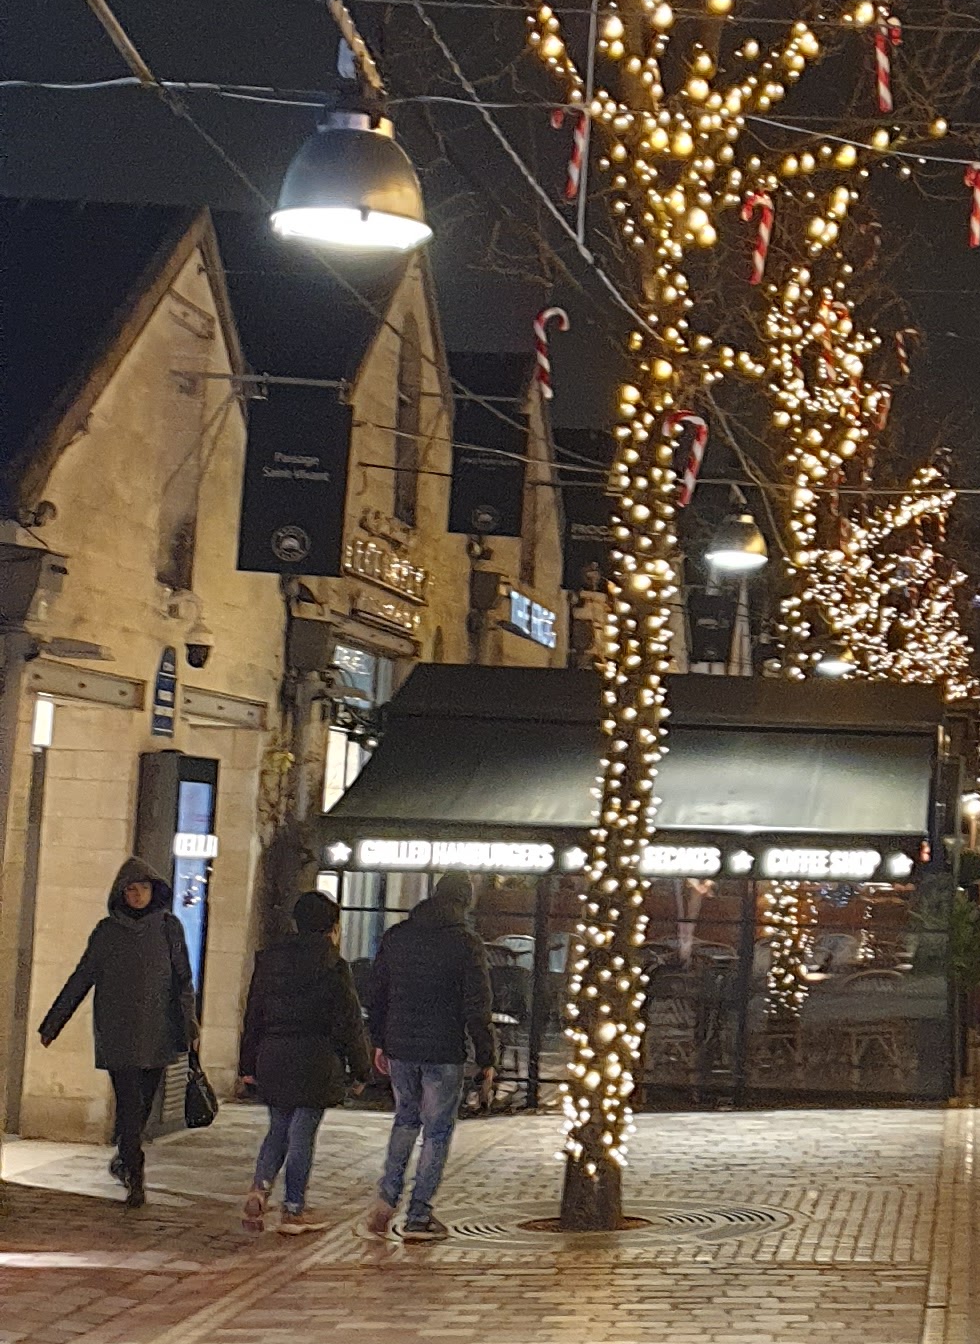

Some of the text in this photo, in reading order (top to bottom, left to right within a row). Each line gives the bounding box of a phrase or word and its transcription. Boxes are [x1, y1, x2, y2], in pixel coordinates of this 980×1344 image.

[360, 841, 881, 875] GRILLED HAMBURGERS SECAKES COFFEE SHOP
